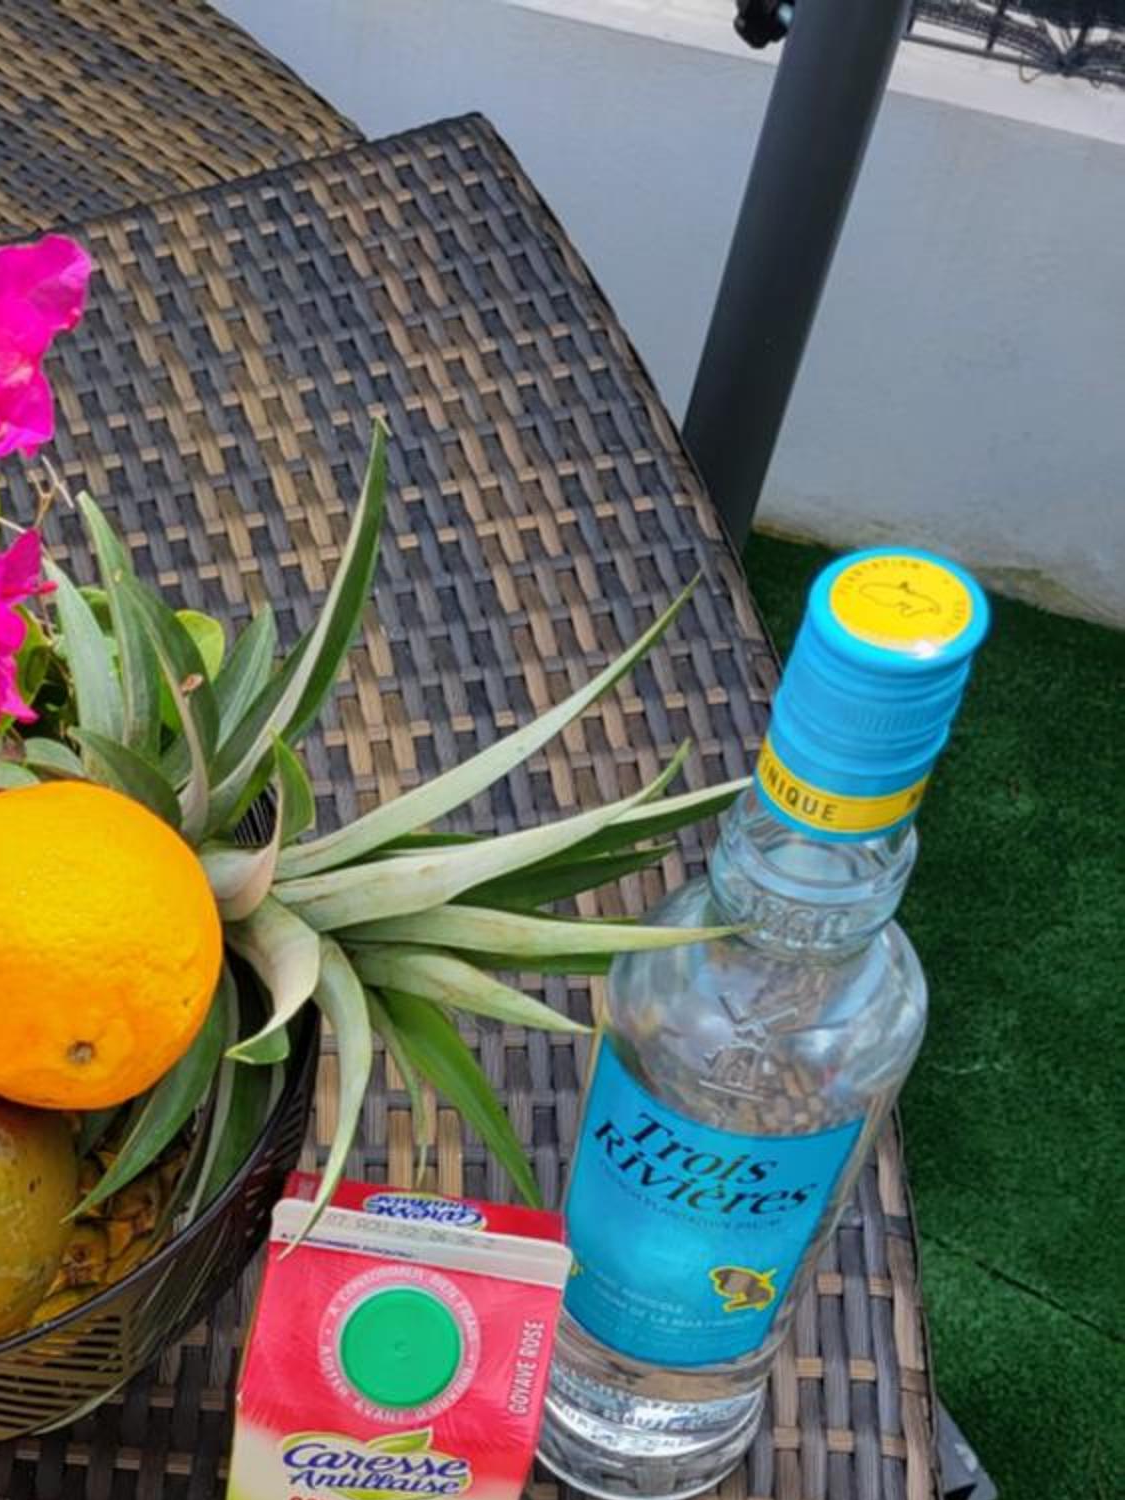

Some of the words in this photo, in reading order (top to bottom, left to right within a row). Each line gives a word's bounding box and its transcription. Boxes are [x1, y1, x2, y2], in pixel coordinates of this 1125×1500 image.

[761, 757, 840, 822] INIQUE
[593, 1119, 819, 1216] Rivières
[631, 1111, 778, 1184] Trois
[519, 1320, 546, 1358] ROSE
[508, 1358, 537, 1415] GOYAVE
[282, 1442, 469, 1478] Caresse
[290, 1466, 461, 1496] Antillaise
